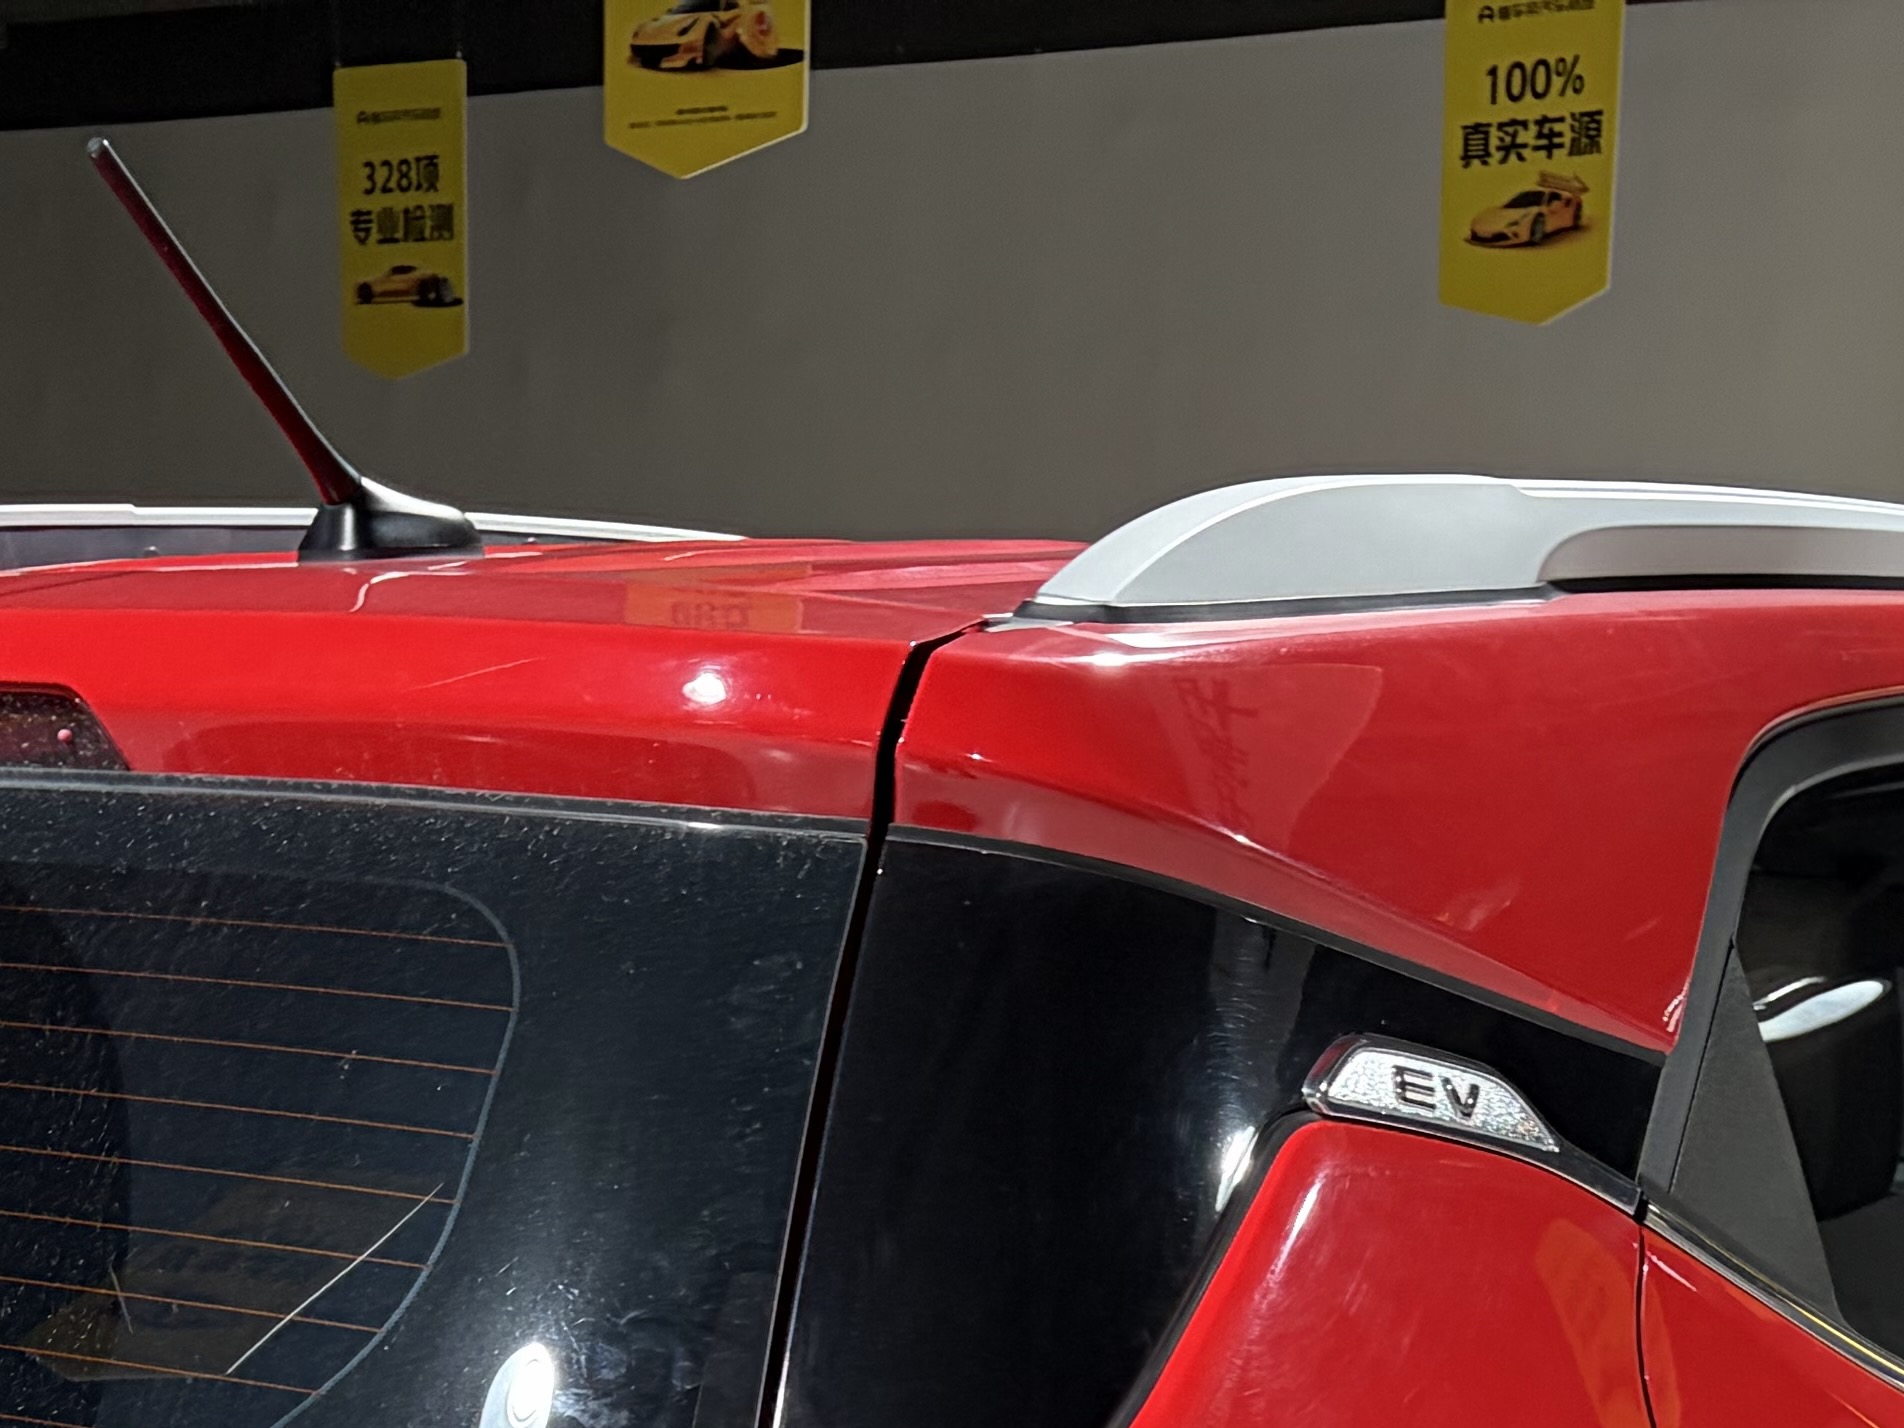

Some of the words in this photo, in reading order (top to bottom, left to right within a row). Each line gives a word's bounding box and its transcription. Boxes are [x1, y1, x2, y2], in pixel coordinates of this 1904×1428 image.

[1486, 54, 1585, 105] 100%
[1460, 109, 1604, 169] 真实车源
[362, 154, 440, 195] 328项
[350, 203, 455, 245] 专业检测
[1392, 1063, 1481, 1120] EV
